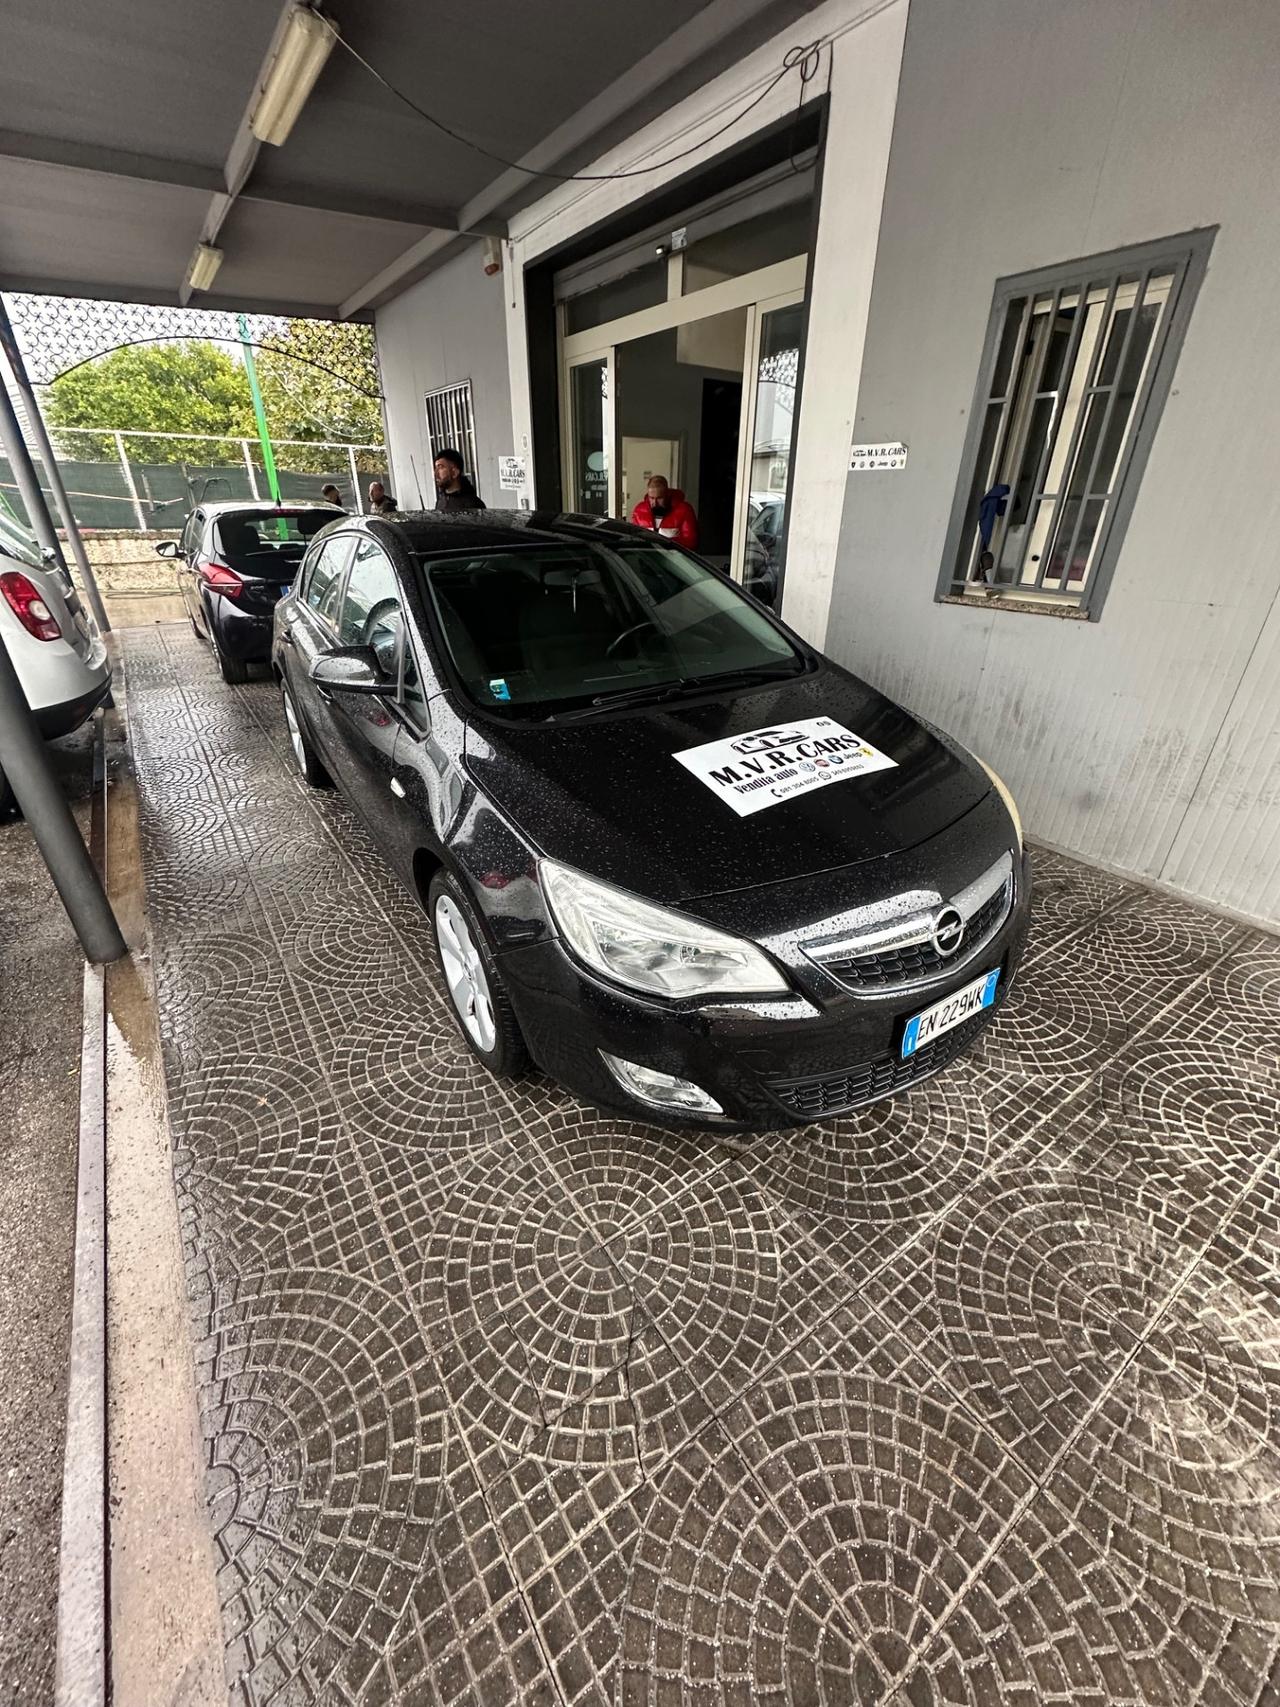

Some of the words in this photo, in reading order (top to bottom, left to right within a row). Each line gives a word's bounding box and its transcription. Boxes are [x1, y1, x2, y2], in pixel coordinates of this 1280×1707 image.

[733, 776, 776, 794] Vendita
[774, 769, 799, 780] auto
[917, 1011, 938, 1041] EN
[939, 984, 986, 1029] 229WK
